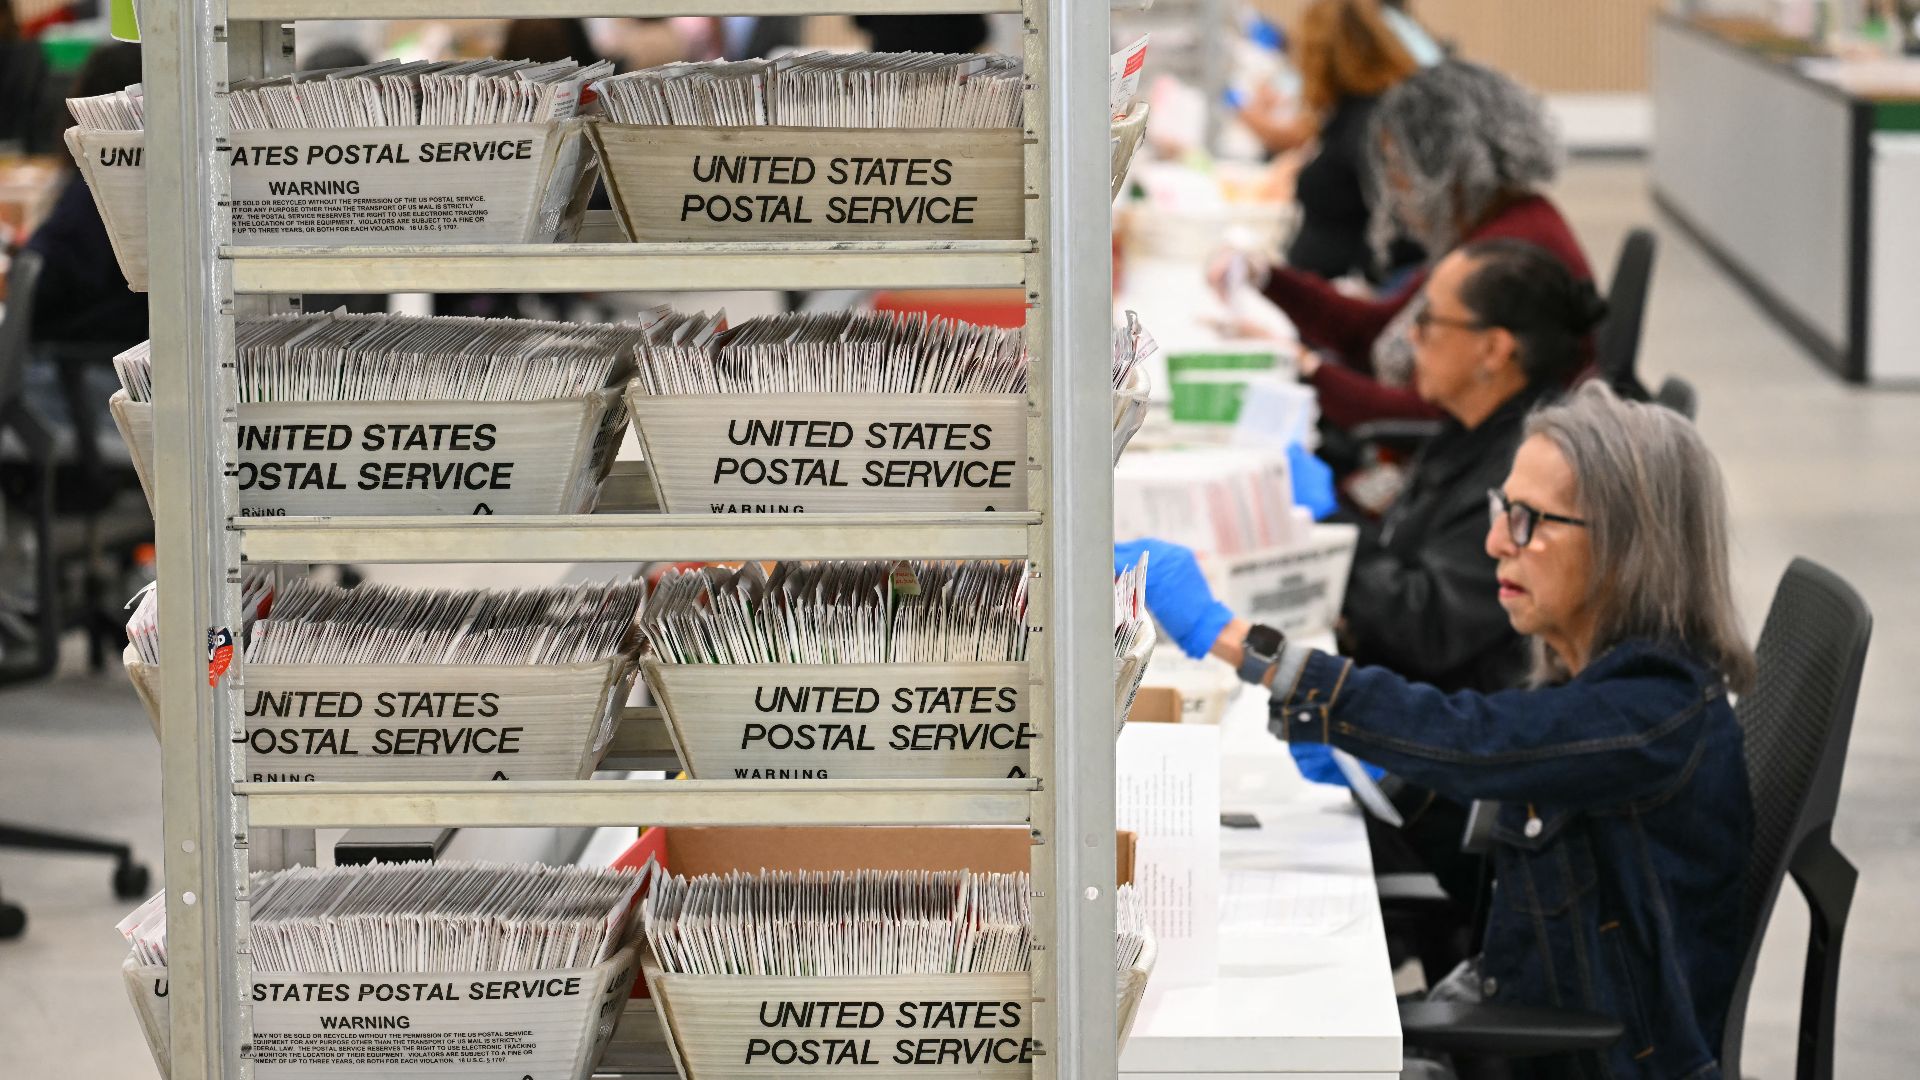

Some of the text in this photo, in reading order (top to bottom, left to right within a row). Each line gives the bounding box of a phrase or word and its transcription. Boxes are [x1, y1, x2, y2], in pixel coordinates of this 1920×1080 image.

[100, 147, 144, 166] UNI
[306, 144, 410, 166] POSTAL
[418, 139, 533, 163] SERVICE
[694, 155, 953, 187] UNITED STATES
[268, 181, 360, 196] WARNING
[681, 195, 977, 224] POSTAL SERVICE
[362, 424, 497, 450] STATES
[728, 419, 992, 450] UNITED STATES
[238, 462, 514, 490] OSTAL SERVICE
[713, 457, 1016, 488] POSTAL SERVICE
[242, 507, 286, 517] RNING
[710, 503, 804, 514] WARNING
[374, 692, 499, 718] STATES
[755, 686, 1017, 714] UNITED STATES
[371, 727, 524, 755] SERVICE
[741, 722, 1036, 751] POSTAL SERVICE
[253, 773, 315, 782] RNING
[735, 768, 828, 779] WARNING
[253, 983, 349, 1003] STATES
[357, 981, 461, 1002] POSTAL
[468, 976, 581, 1000] SERVICE
[320, 1015, 411, 1030] WARNING
[759, 1001, 1022, 1029] UNITED STATES
[745, 1037, 1032, 1065] POSTAL SERVICE
